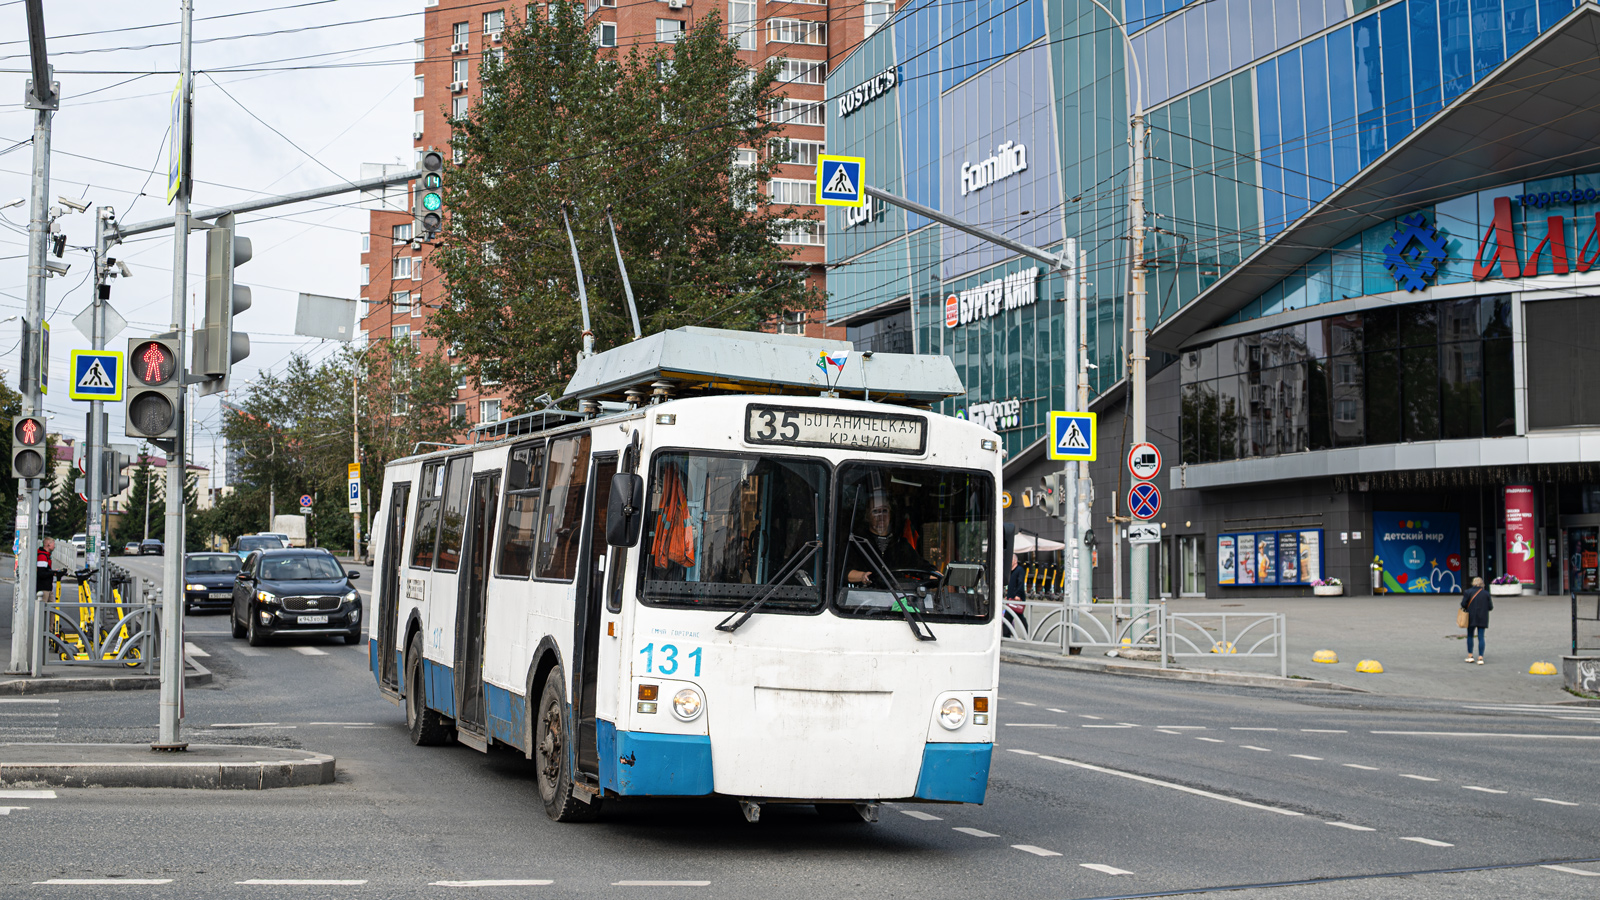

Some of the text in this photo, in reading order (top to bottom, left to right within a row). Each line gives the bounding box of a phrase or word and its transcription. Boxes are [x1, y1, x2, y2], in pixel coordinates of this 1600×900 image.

[838, 65, 895, 117] ROSTIC'S
[427, 176, 439, 188] 14
[960, 266, 1039, 325] БУРГЕР КИНГ
[757, 410, 917, 441] 35 БОТАНИЧЕСКАЯ
[1383, 531, 1444, 543] детский мир
[1412, 550, 1417, 559] 1
[640, 643, 703, 677] 131
